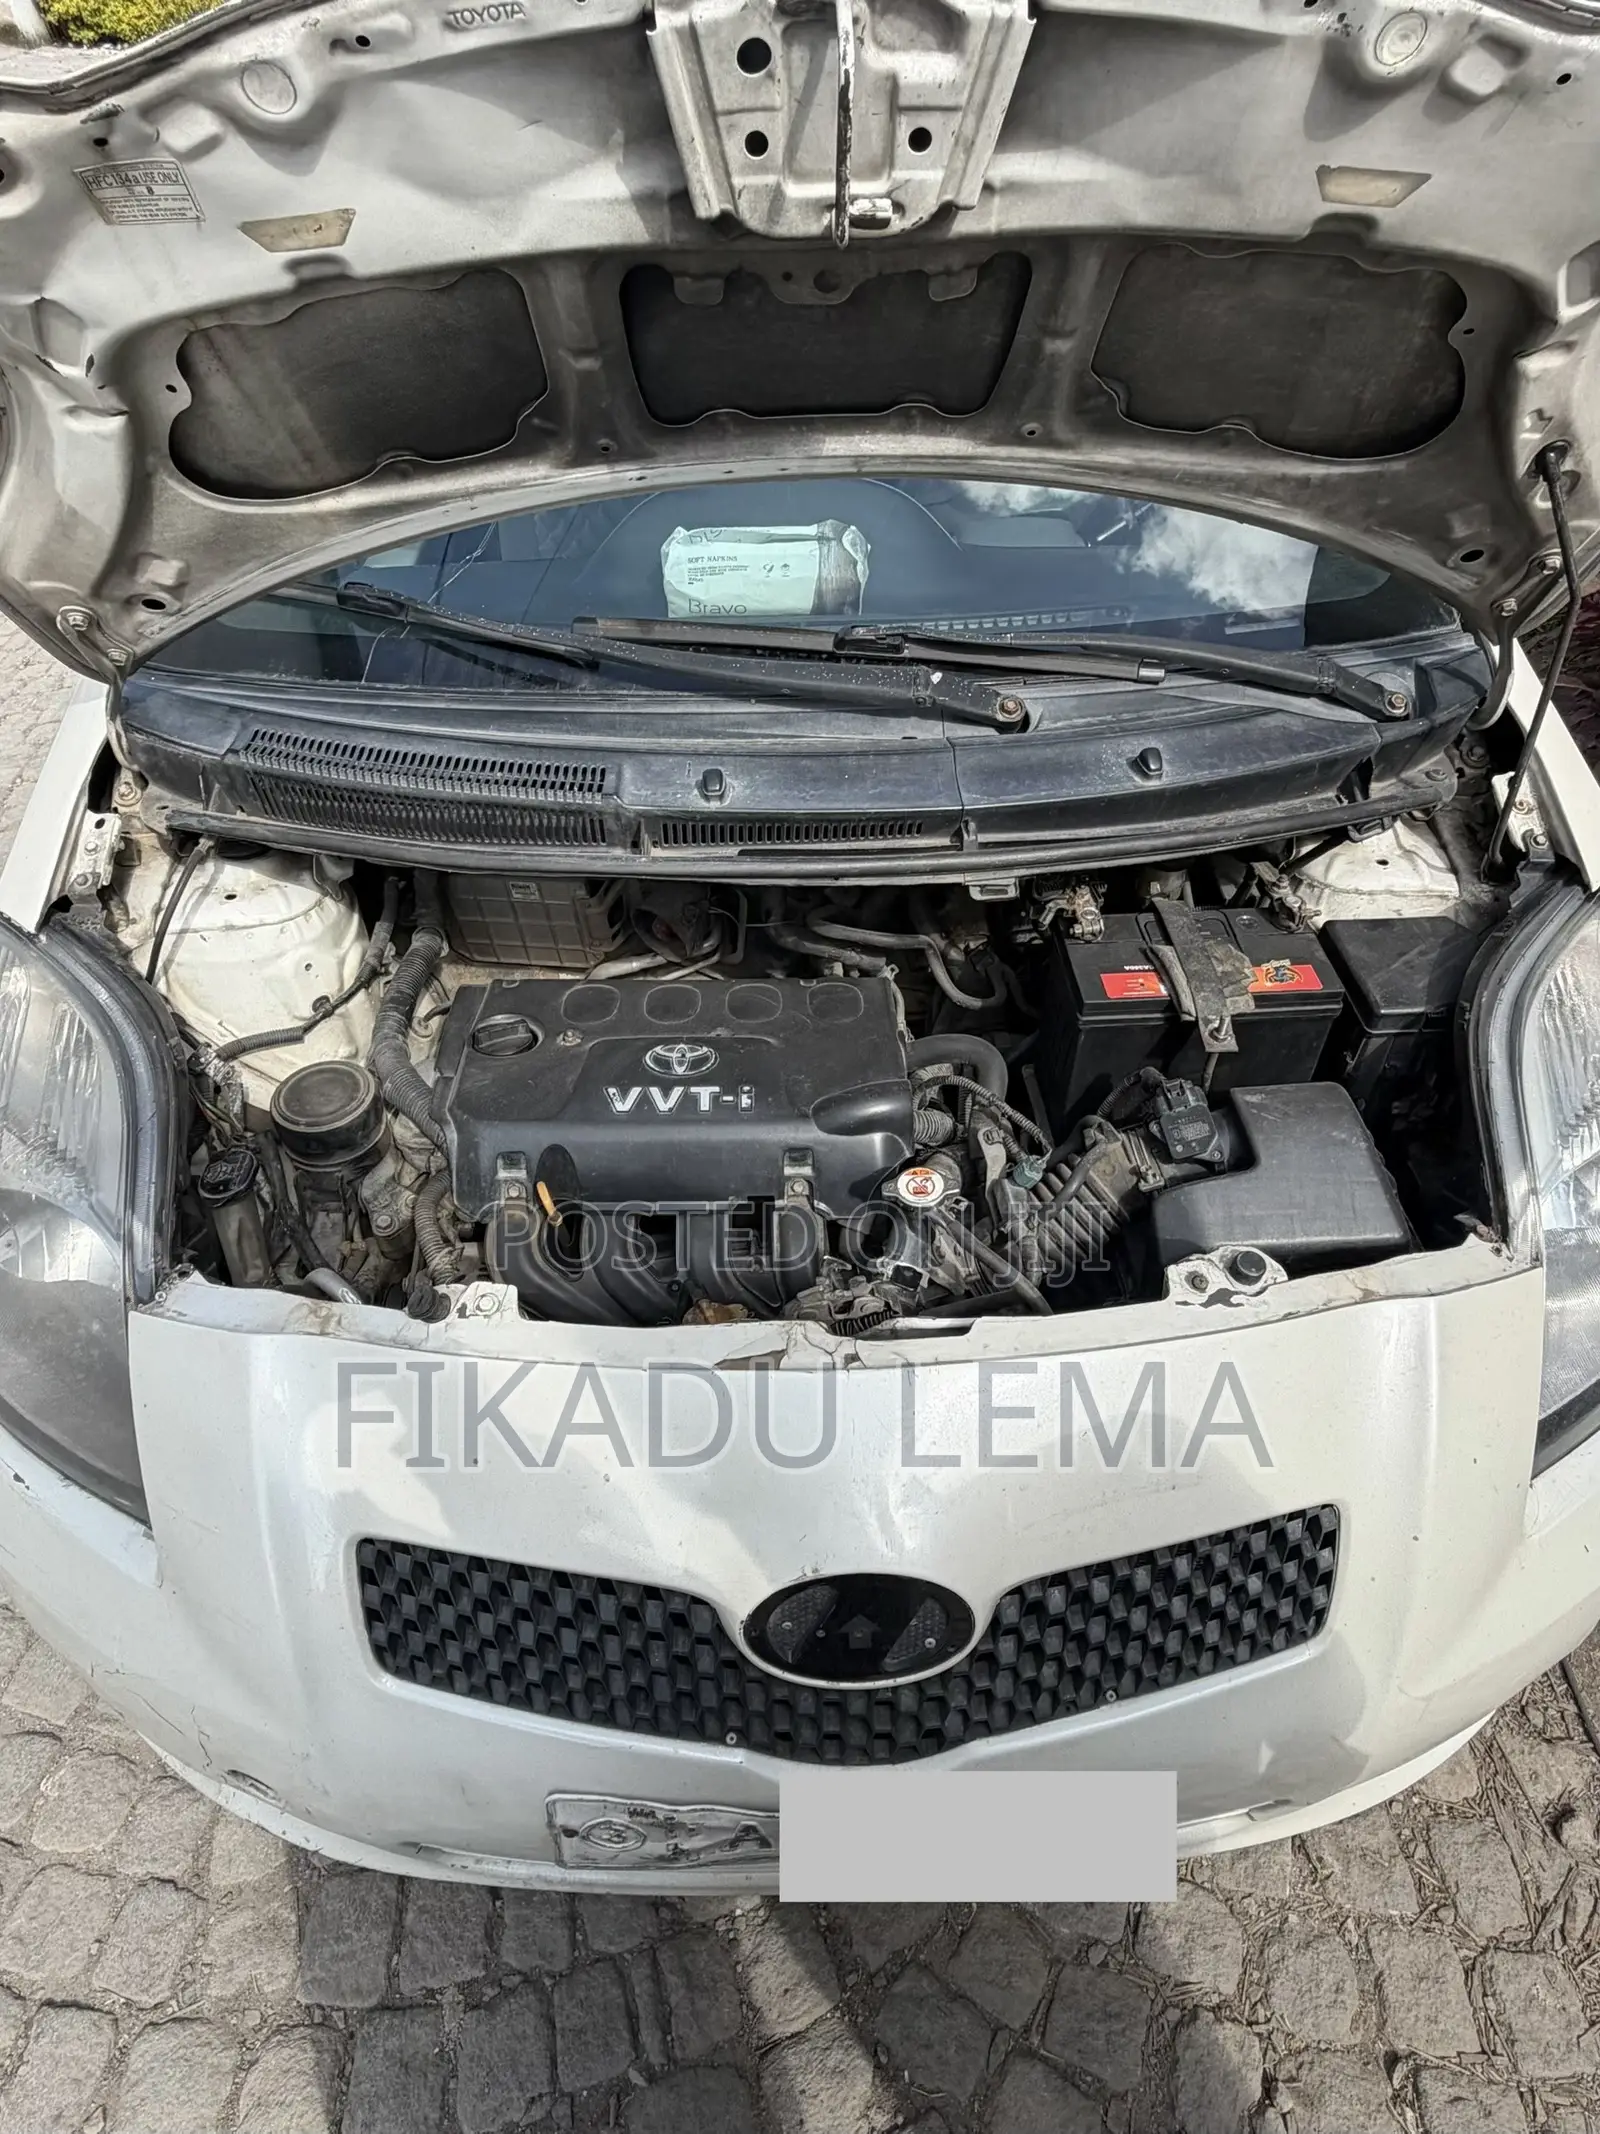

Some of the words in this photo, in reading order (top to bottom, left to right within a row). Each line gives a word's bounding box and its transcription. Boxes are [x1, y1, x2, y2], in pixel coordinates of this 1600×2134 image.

[447, 2, 526, 25] TOYOTA
[140, 172, 158, 184] USE
[158, 171, 180, 184] ONLY
[688, 556, 705, 564] SOFT
[688, 598, 747, 614] Bravo
[604, 1086, 755, 1114] VVT-i
